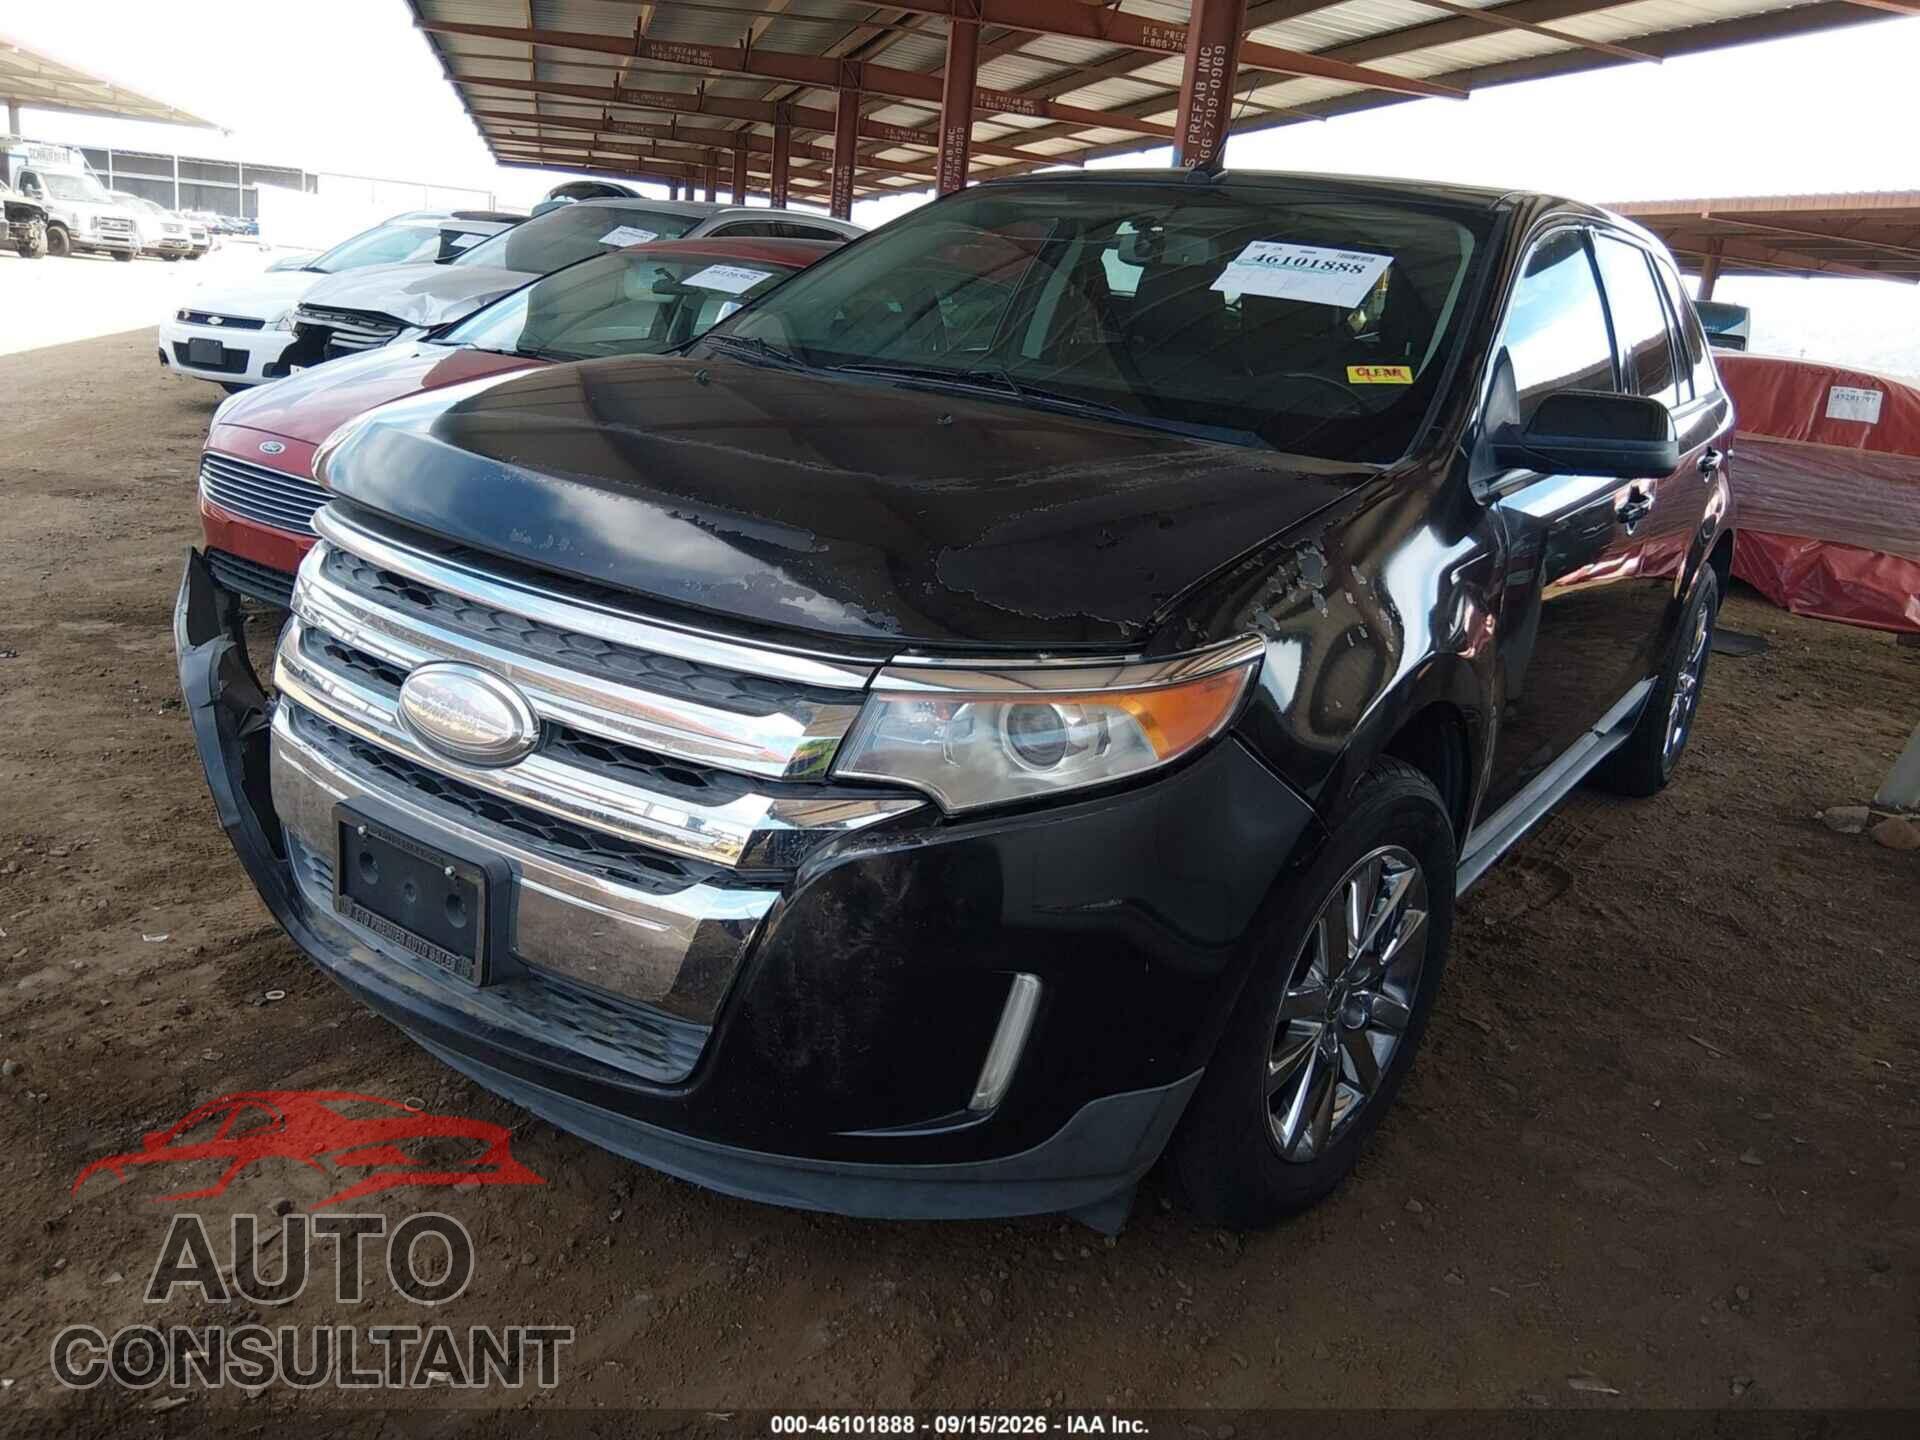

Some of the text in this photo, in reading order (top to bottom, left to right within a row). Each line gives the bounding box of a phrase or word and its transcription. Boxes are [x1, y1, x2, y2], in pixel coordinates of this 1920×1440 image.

[1188, 82, 1208, 144] PREFAB
[1199, 45, 1226, 164] 66-799-0969
[1252, 253, 1366, 275] 46101888
[406, 934, 428, 956] AUTO
[429, 950, 457, 971] SALES
